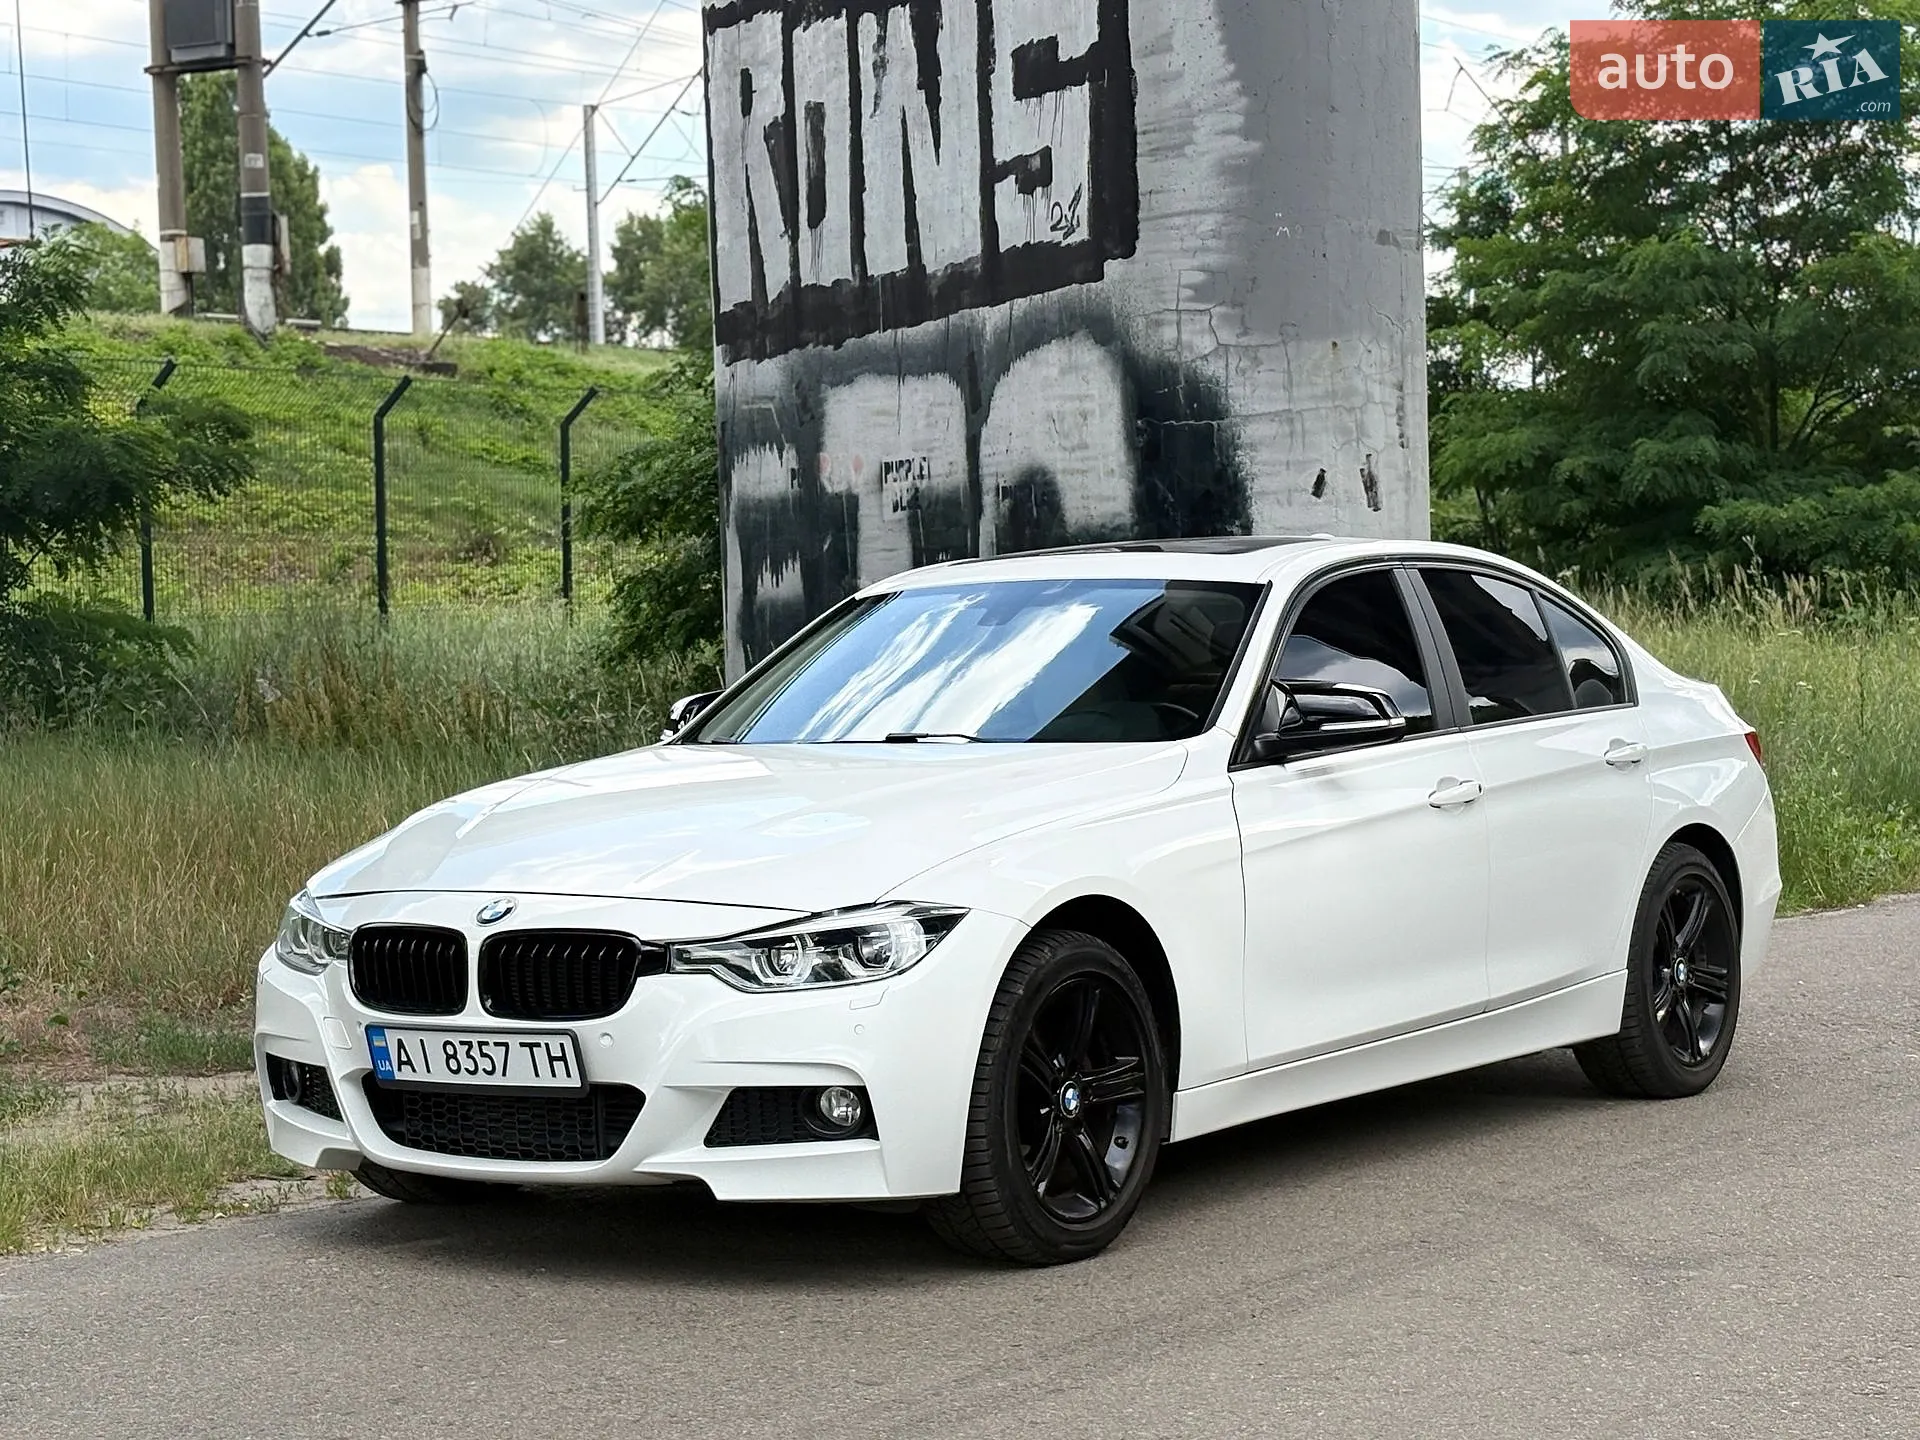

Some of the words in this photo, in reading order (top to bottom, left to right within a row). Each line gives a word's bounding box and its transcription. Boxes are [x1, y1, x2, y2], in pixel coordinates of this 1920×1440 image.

[378, 1059, 393, 1072] UA
[397, 1038, 432, 1074] AI
[442, 1040, 510, 1077] 8357
[519, 1042, 572, 1079] TH
